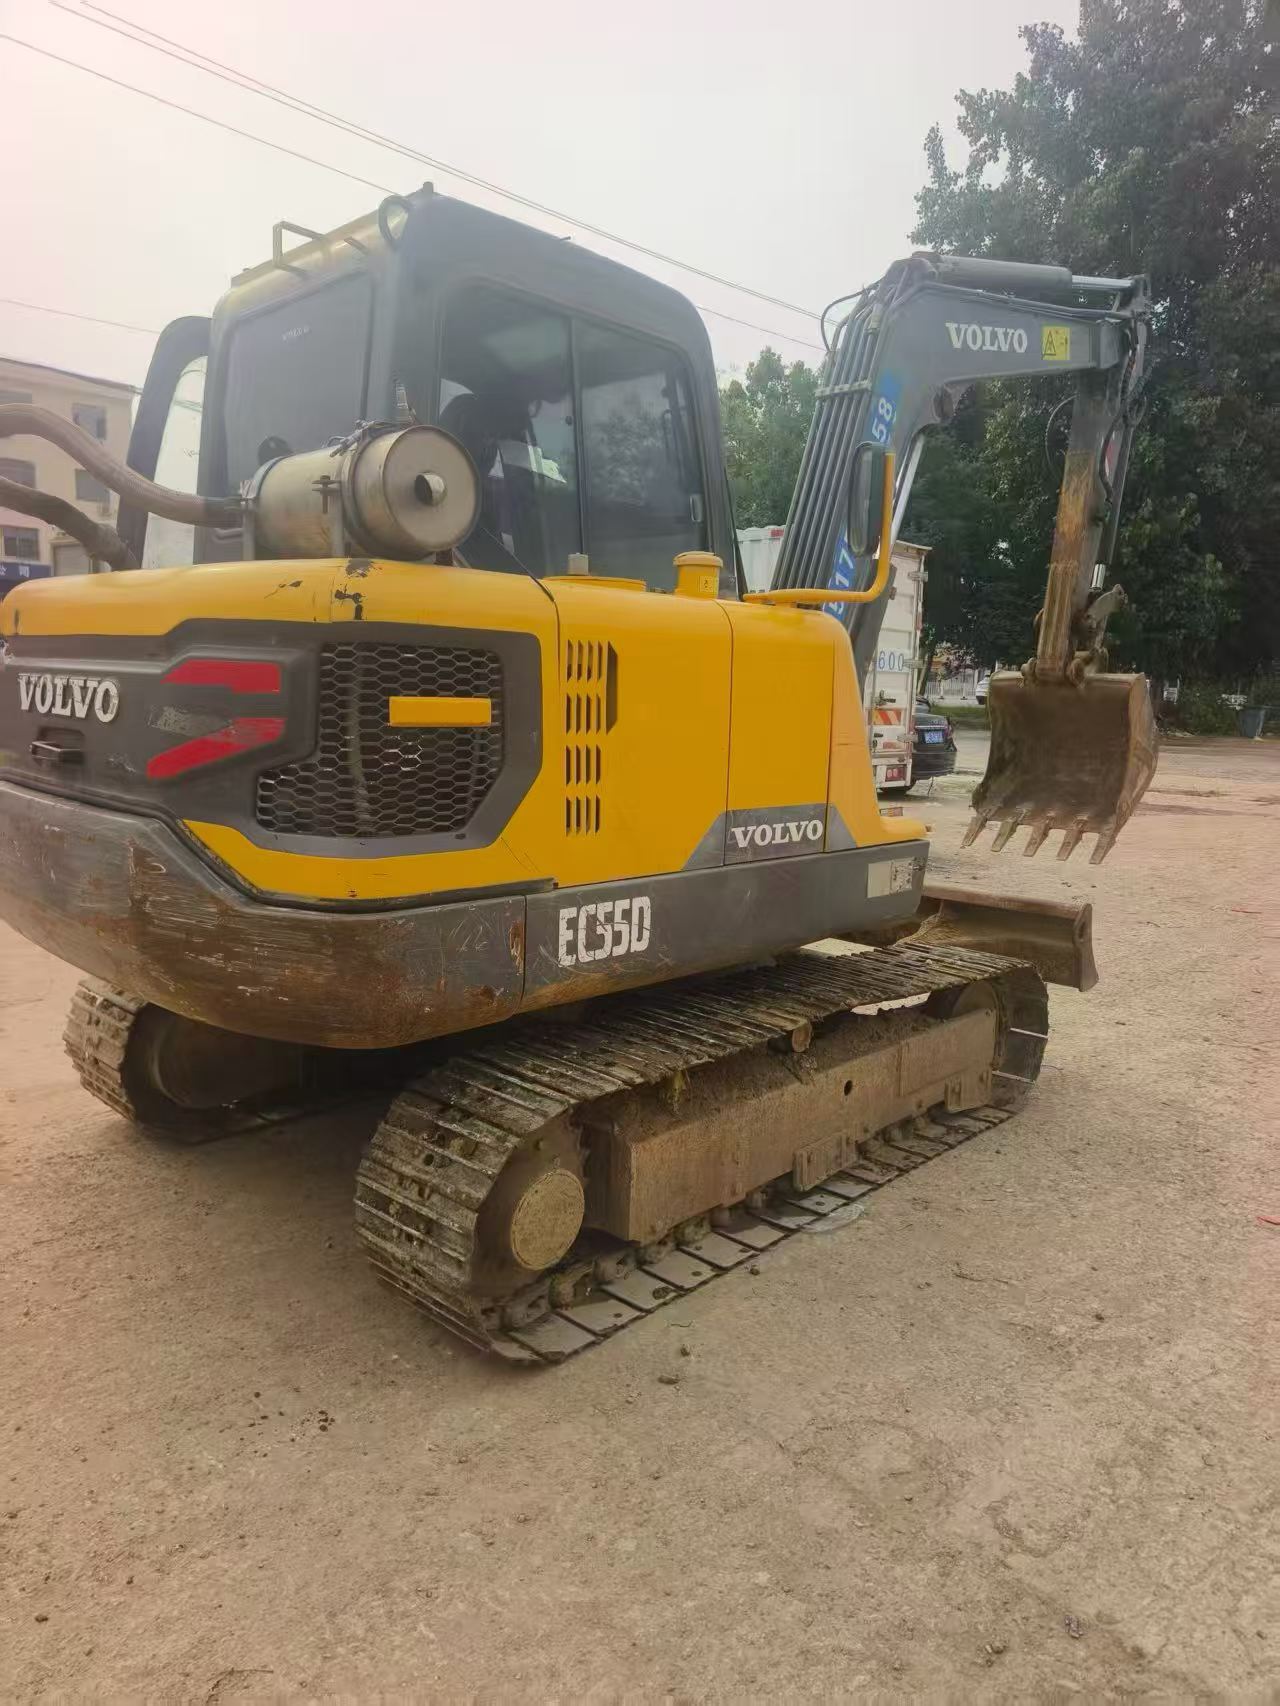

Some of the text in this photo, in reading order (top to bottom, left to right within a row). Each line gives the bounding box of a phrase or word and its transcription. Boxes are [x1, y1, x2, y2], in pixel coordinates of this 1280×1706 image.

[944, 322, 1028, 353] VOLVO
[878, 651, 905, 671] 600
[18, 673, 120, 723] VOLVO
[731, 819, 824, 848] VOLVO
[558, 896, 652, 967] EC55D
